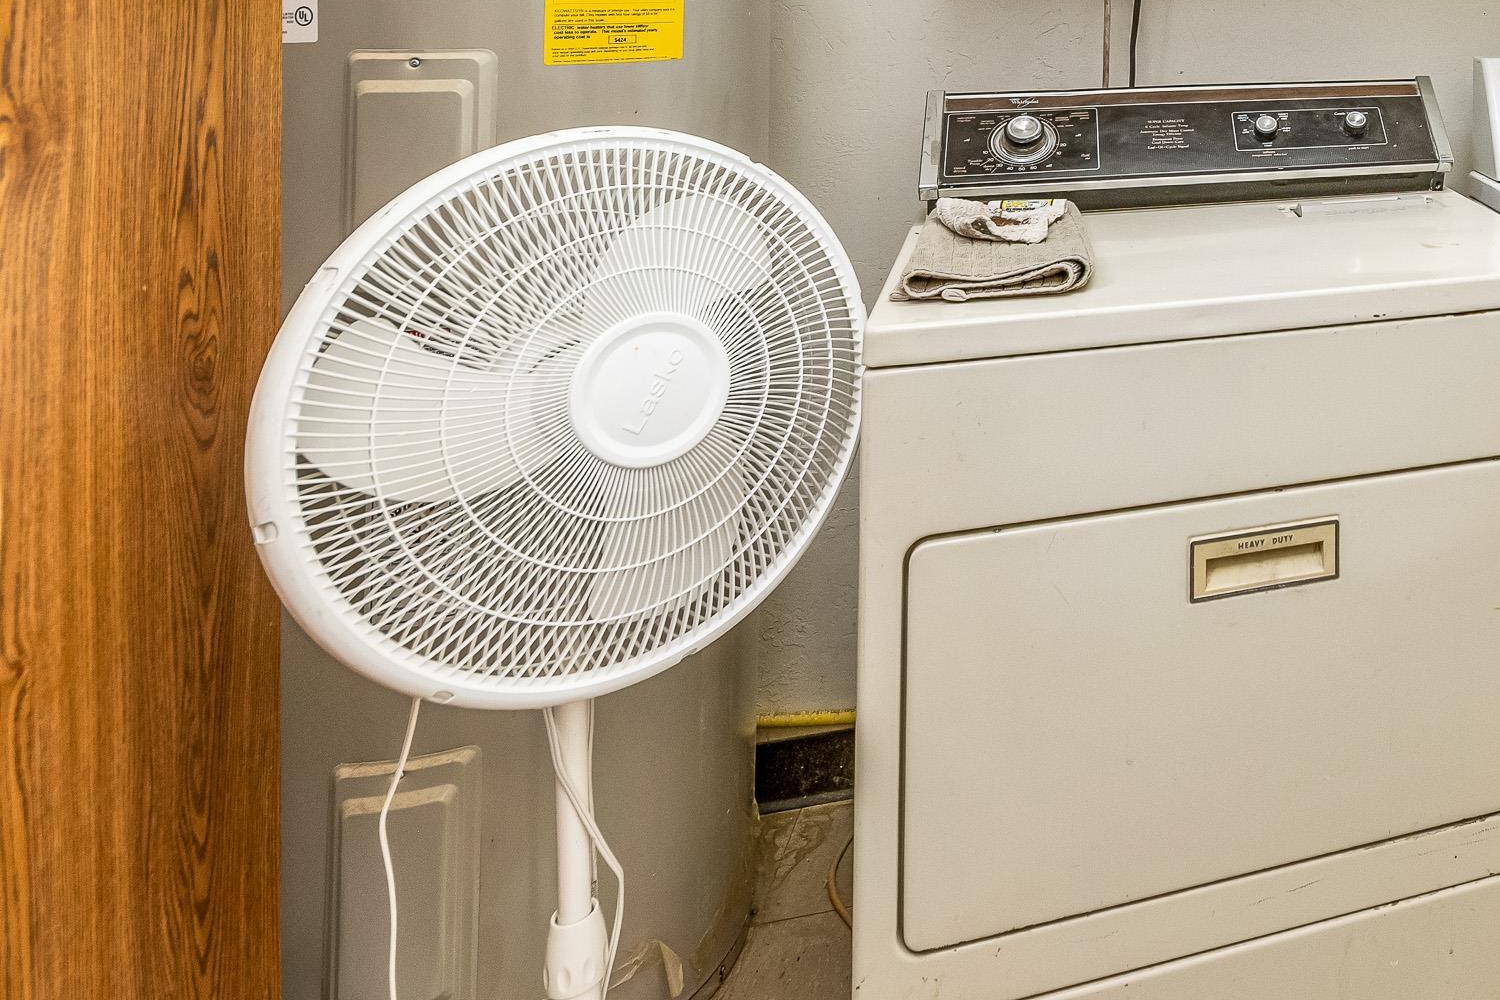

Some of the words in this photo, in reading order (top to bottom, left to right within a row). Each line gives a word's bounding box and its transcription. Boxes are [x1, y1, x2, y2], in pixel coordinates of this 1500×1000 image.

[621, 349, 684, 436] Lasko
[1238, 540, 1265, 550] HEAVY
[1273, 534, 1293, 545] DUTY
